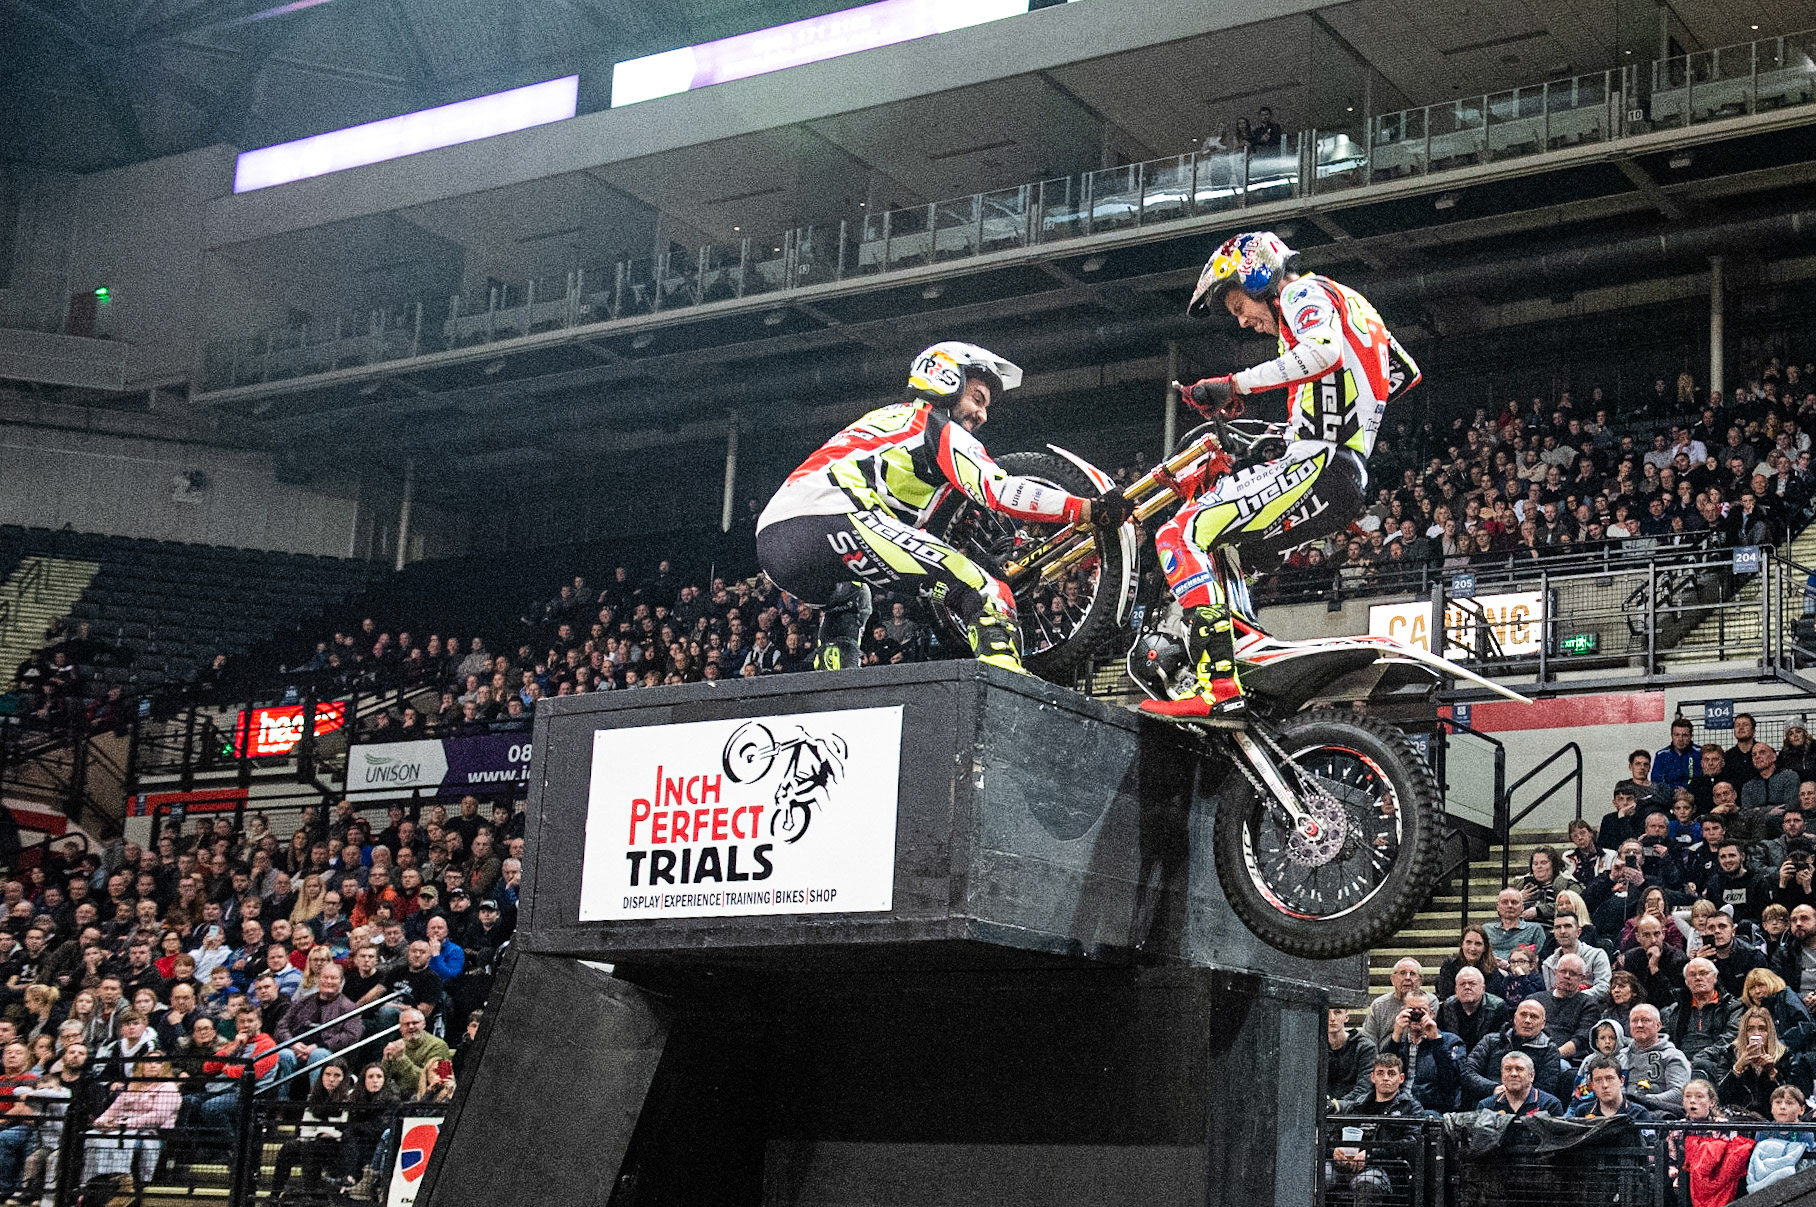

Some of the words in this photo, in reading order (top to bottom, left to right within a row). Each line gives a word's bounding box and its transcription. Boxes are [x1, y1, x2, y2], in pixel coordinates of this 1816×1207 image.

[826, 531, 891, 588] TRS
[1736, 552, 1756, 563] 204
[1454, 579, 1472, 589] 205
[1133, 611, 1144, 619] 20
[1707, 706, 1730, 718] 104
[366, 763, 421, 784] UNISON
[655, 765, 722, 807] INCH
[629, 798, 764, 846] PERFECT
[626, 843, 774, 887] TRIALS
[623, 894, 661, 910] DISPLAY
[664, 893, 722, 908] EXPERIENCE
[726, 891, 771, 906] TRAINING
[775, 889, 805, 904] BIKES
[809, 888, 837, 903] SHOP
